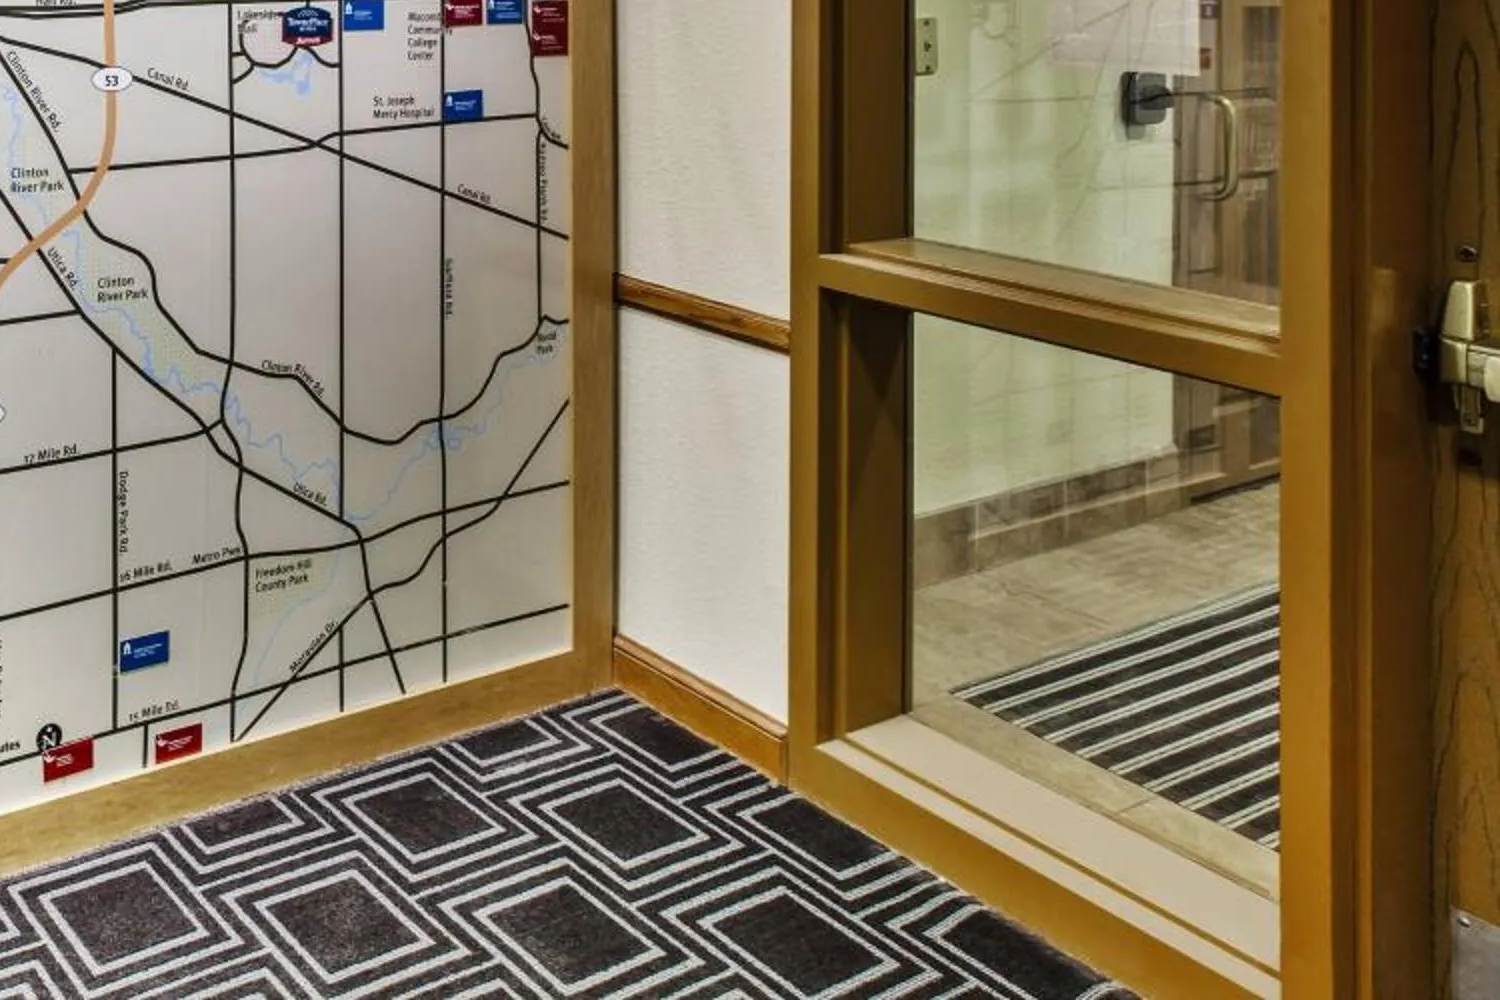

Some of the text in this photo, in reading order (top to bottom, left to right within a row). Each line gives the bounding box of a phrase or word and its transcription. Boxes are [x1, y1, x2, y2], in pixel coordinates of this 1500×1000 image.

[6, 50, 33, 90] Clinton
[105, 75, 119, 87] 53
[10, 166, 49, 181] Clinton
[10, 178, 64, 195] River Park
[46, 247, 69, 279] Utica
[97, 275, 135, 290] Clinton
[97, 286, 149, 303] River Park
[37, 447, 60, 461] Mile
[133, 565, 155, 579] Mile
[286, 573, 309, 587] Park
[141, 705, 163, 719] Mile
